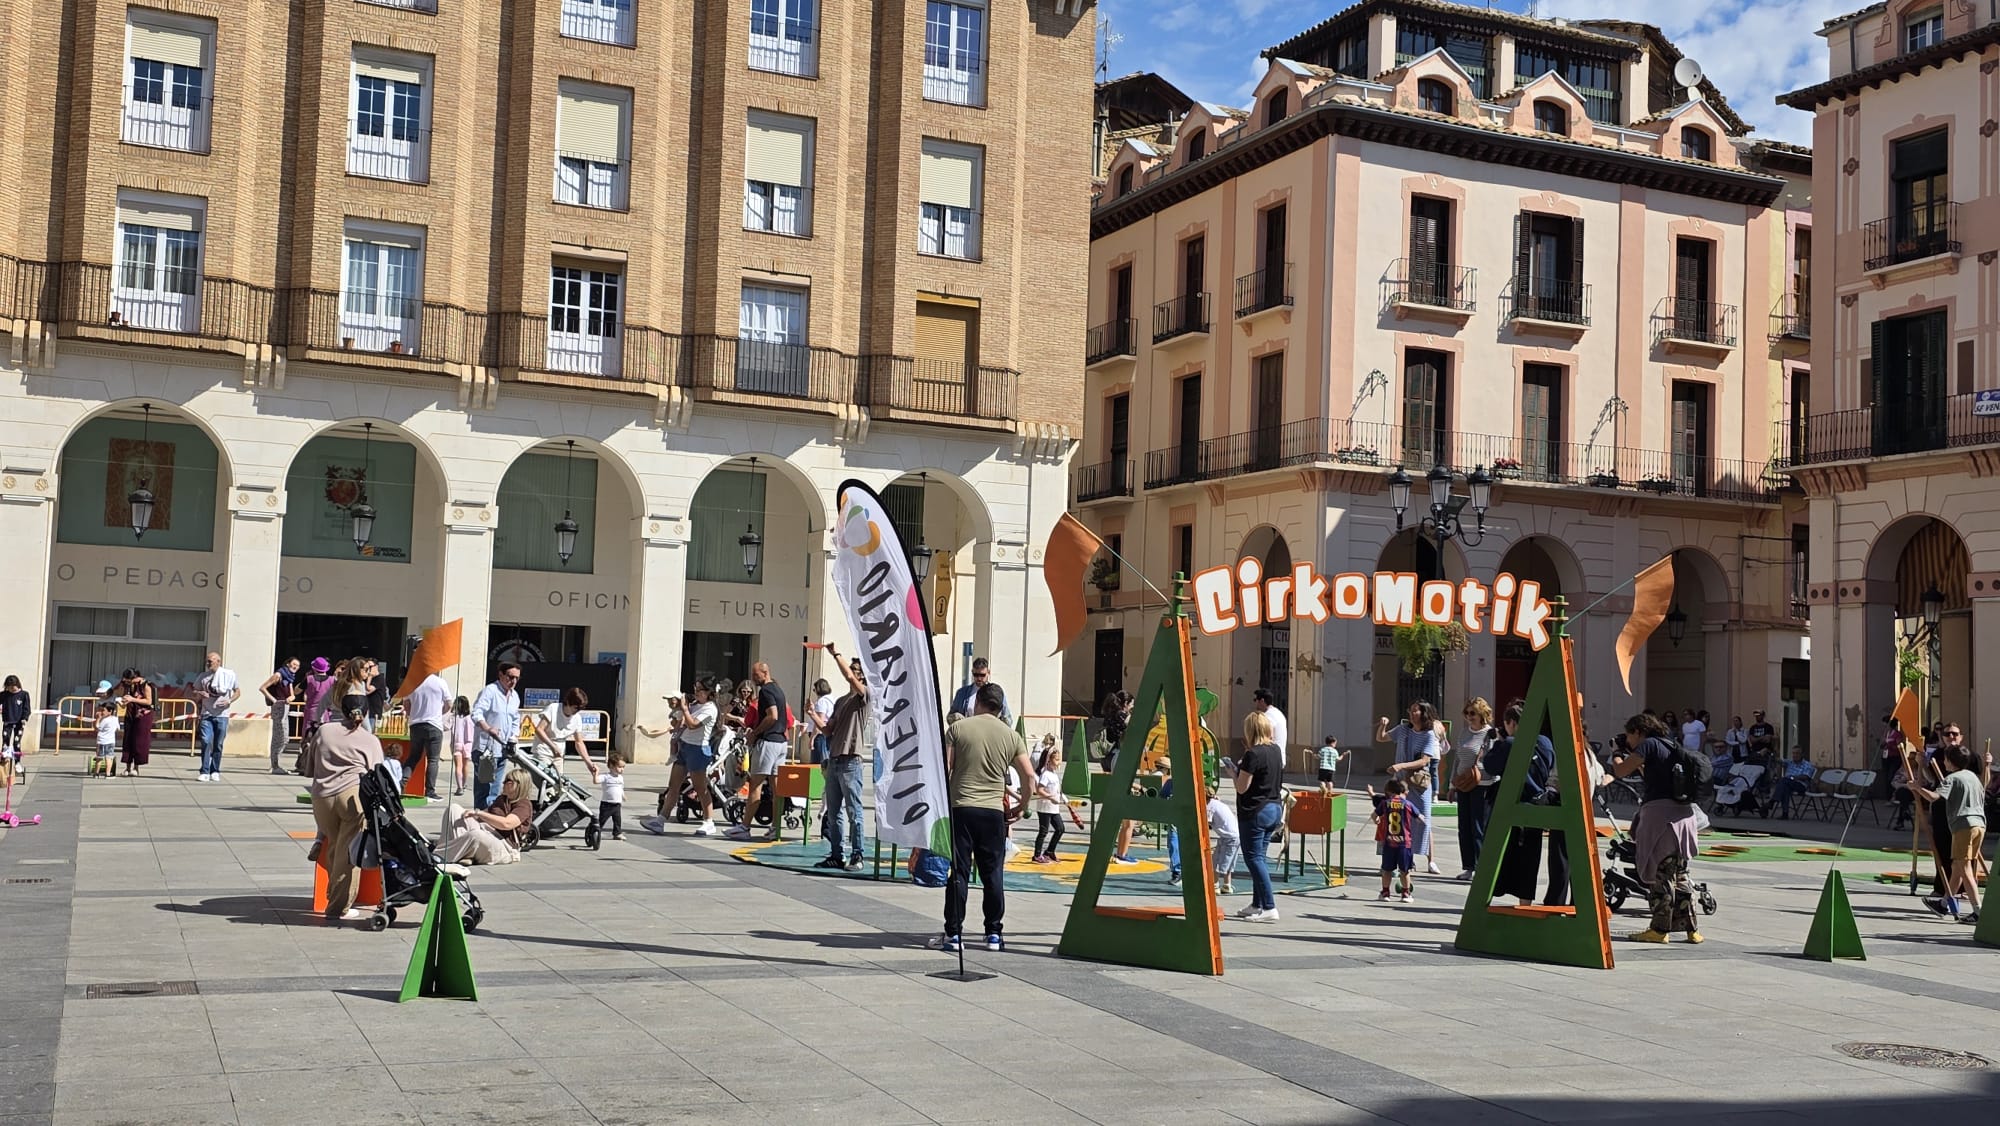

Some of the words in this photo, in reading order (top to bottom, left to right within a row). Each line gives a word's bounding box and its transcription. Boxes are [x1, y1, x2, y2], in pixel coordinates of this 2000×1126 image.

[1985, 402, 2000, 412] VEN
[57, 563, 76, 582] O
[548, 590, 631, 610] OFICIN
[688, 598, 701, 615] E
[719, 600, 809, 621] TURISM
[1376, 637, 1394, 649] ARA
[1388, 811, 1401, 835] 8
